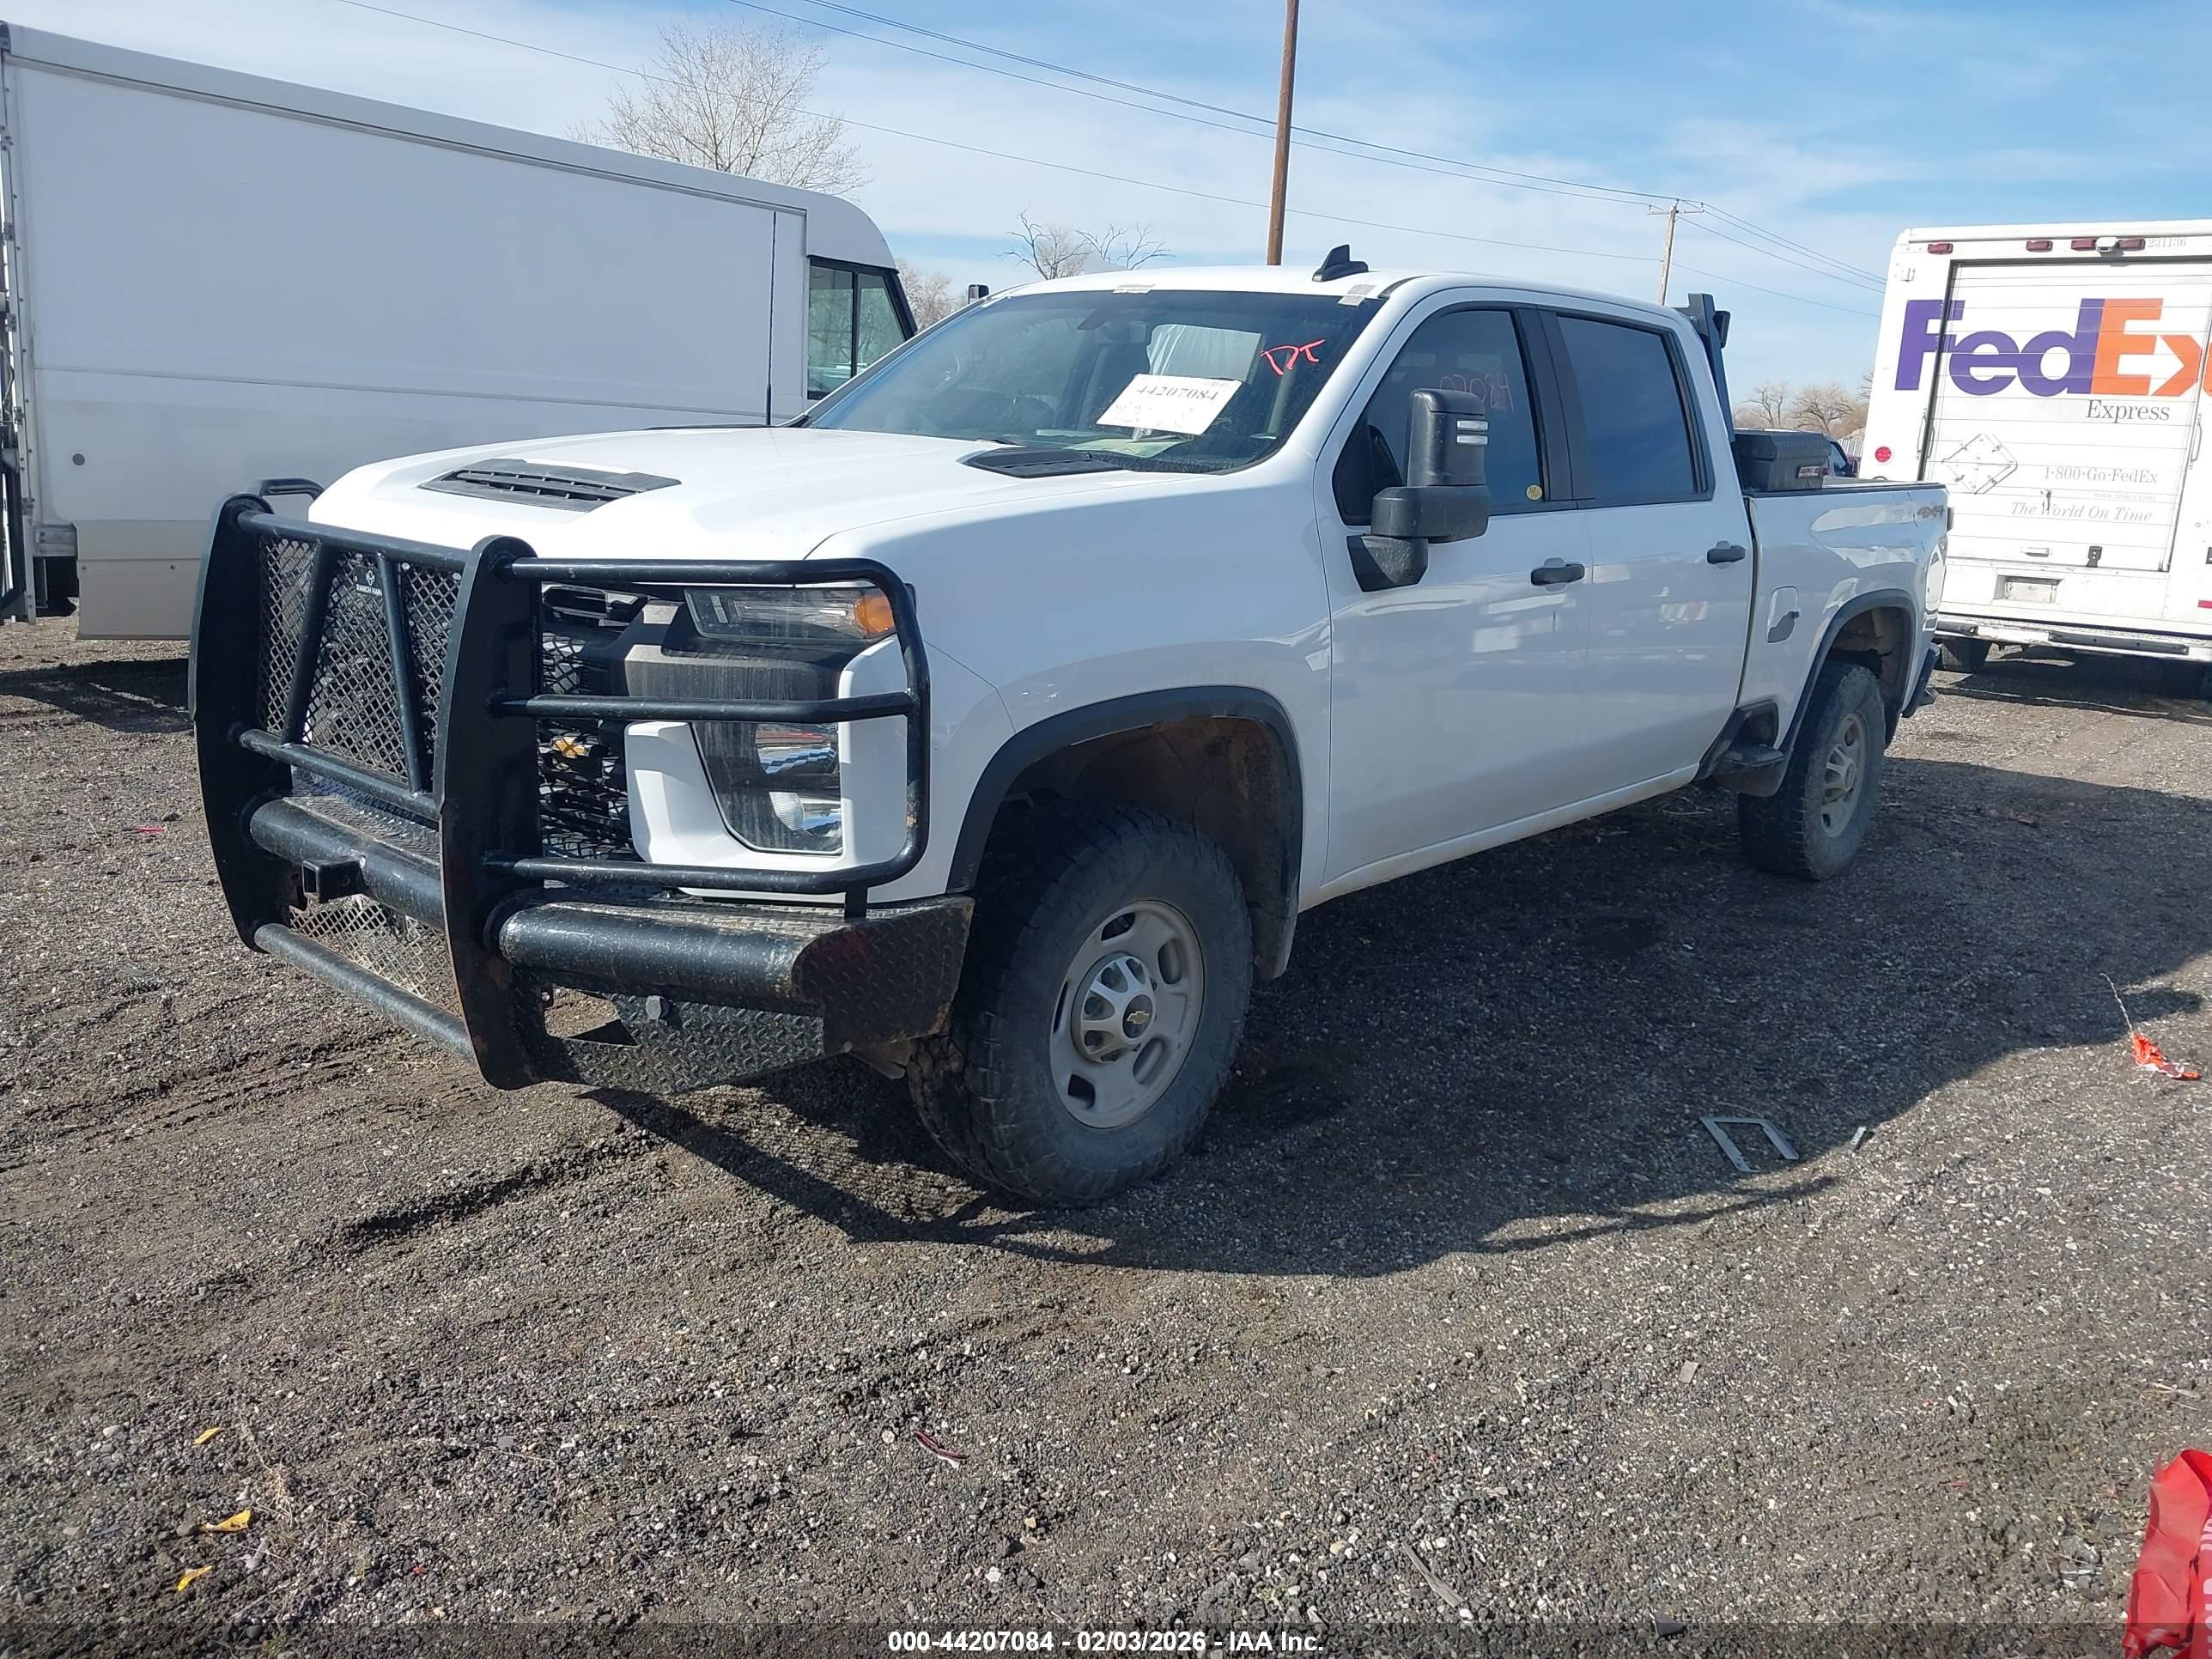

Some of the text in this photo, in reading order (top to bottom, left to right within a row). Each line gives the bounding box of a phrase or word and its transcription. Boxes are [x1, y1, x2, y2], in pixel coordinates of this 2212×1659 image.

[1894, 298, 2212, 397] FedEx
[1136, 385, 1219, 401] 44207084
[2086, 399, 2170, 423] Express
[2011, 501, 2038, 515] The
[2088, 505, 2109, 519] On
[2113, 506, 2154, 522] Time
[356, 584, 384, 597] RANCH HAN
